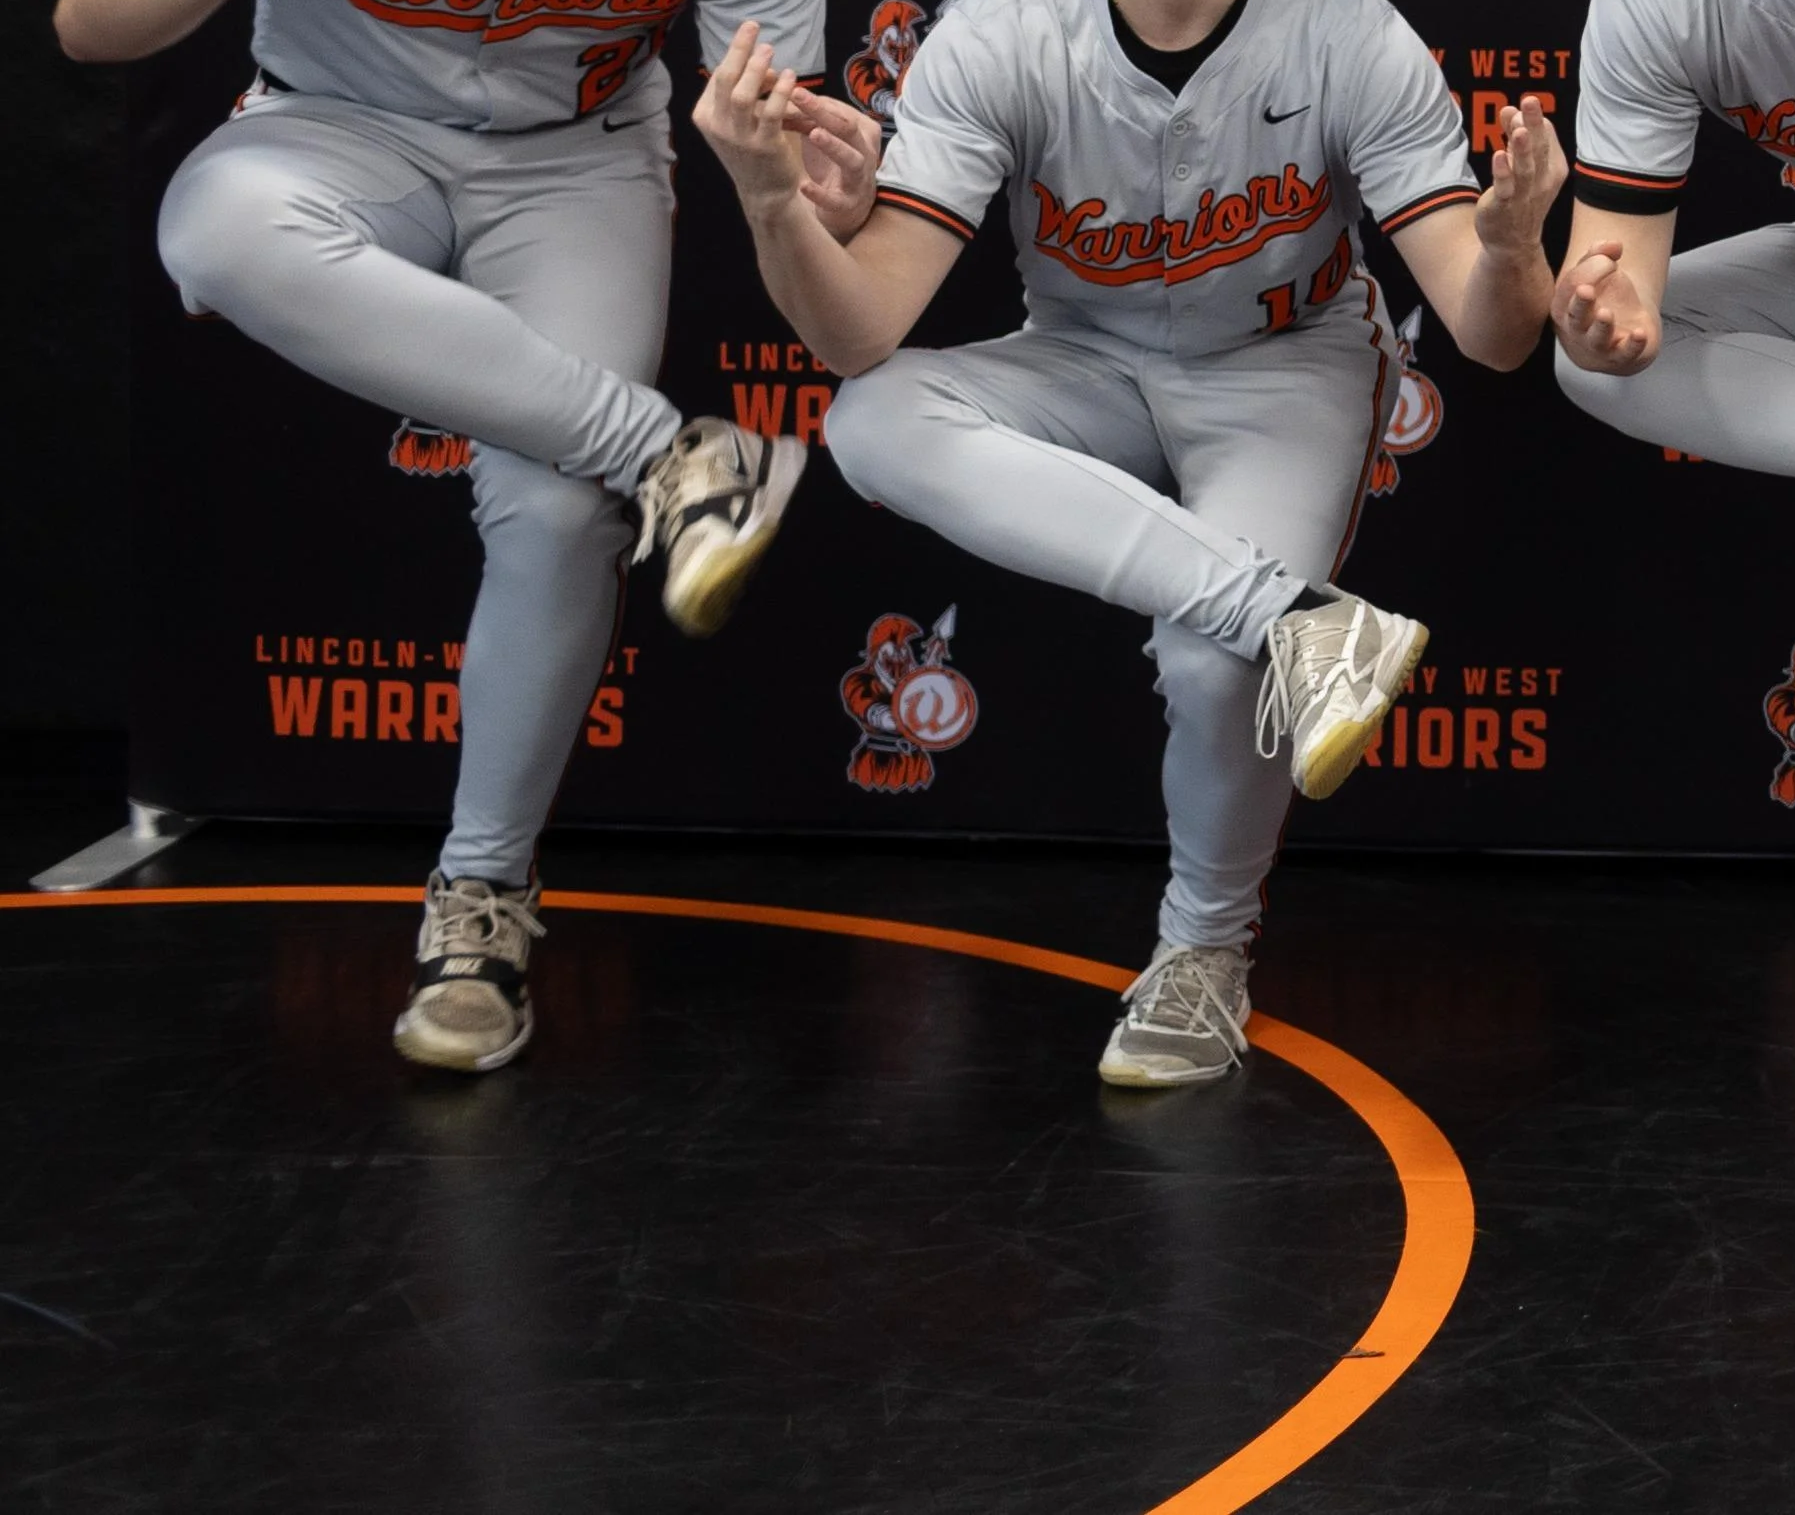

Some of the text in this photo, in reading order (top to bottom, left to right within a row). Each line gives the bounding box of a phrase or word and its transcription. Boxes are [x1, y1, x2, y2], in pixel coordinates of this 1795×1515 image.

[1471, 50, 1570, 78] WEST
[1031, 163, 1332, 271] Warriors
[257, 636, 464, 669] LINCOLN-W
[1464, 669, 1560, 695] WEST
